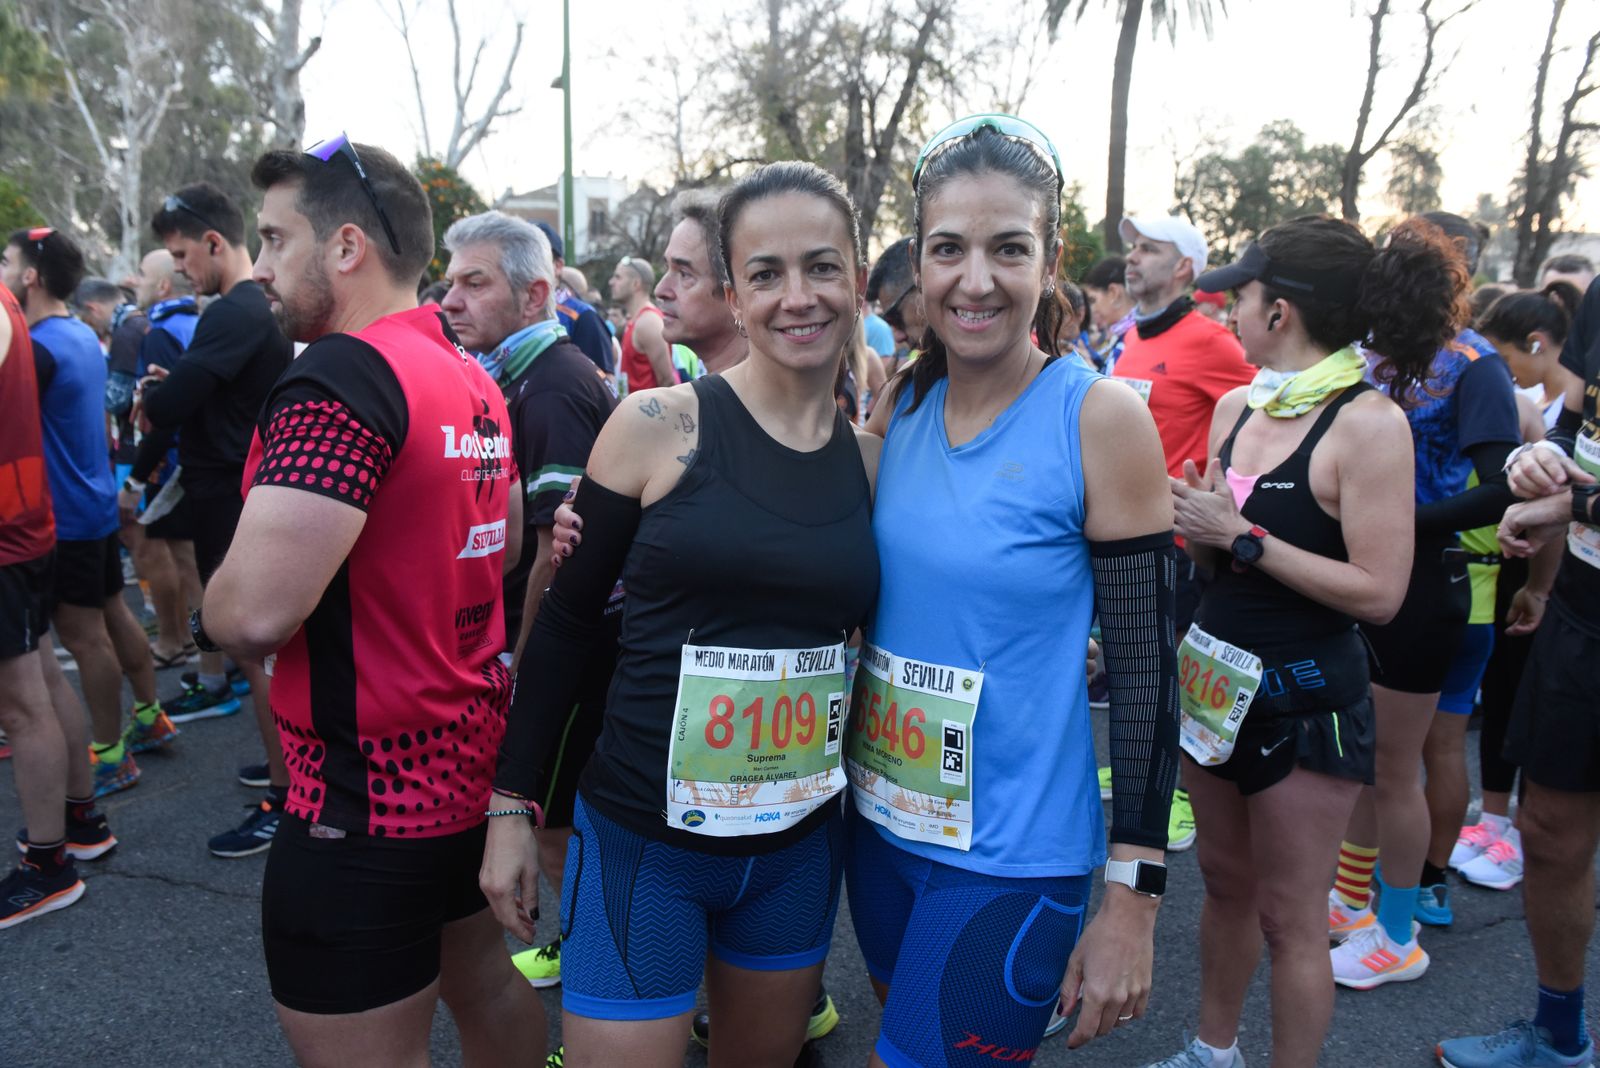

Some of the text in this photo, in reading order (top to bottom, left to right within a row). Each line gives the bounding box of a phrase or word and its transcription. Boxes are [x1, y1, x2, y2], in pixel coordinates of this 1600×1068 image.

[695, 648, 837, 674] MEDIO MARATÓN SEVILLA
[1221, 645, 1254, 671] SEVILLA
[902, 661, 955, 694] SEVILLA
[1179, 655, 1230, 710] 9216
[704, 692, 816, 750] 8109
[855, 686, 926, 760] 6546
[746, 753, 787, 764] Suprema
[729, 774, 764, 783] GRAGEA
[754, 811, 781, 823] HOKA
[874, 803, 891, 820] HOKA
